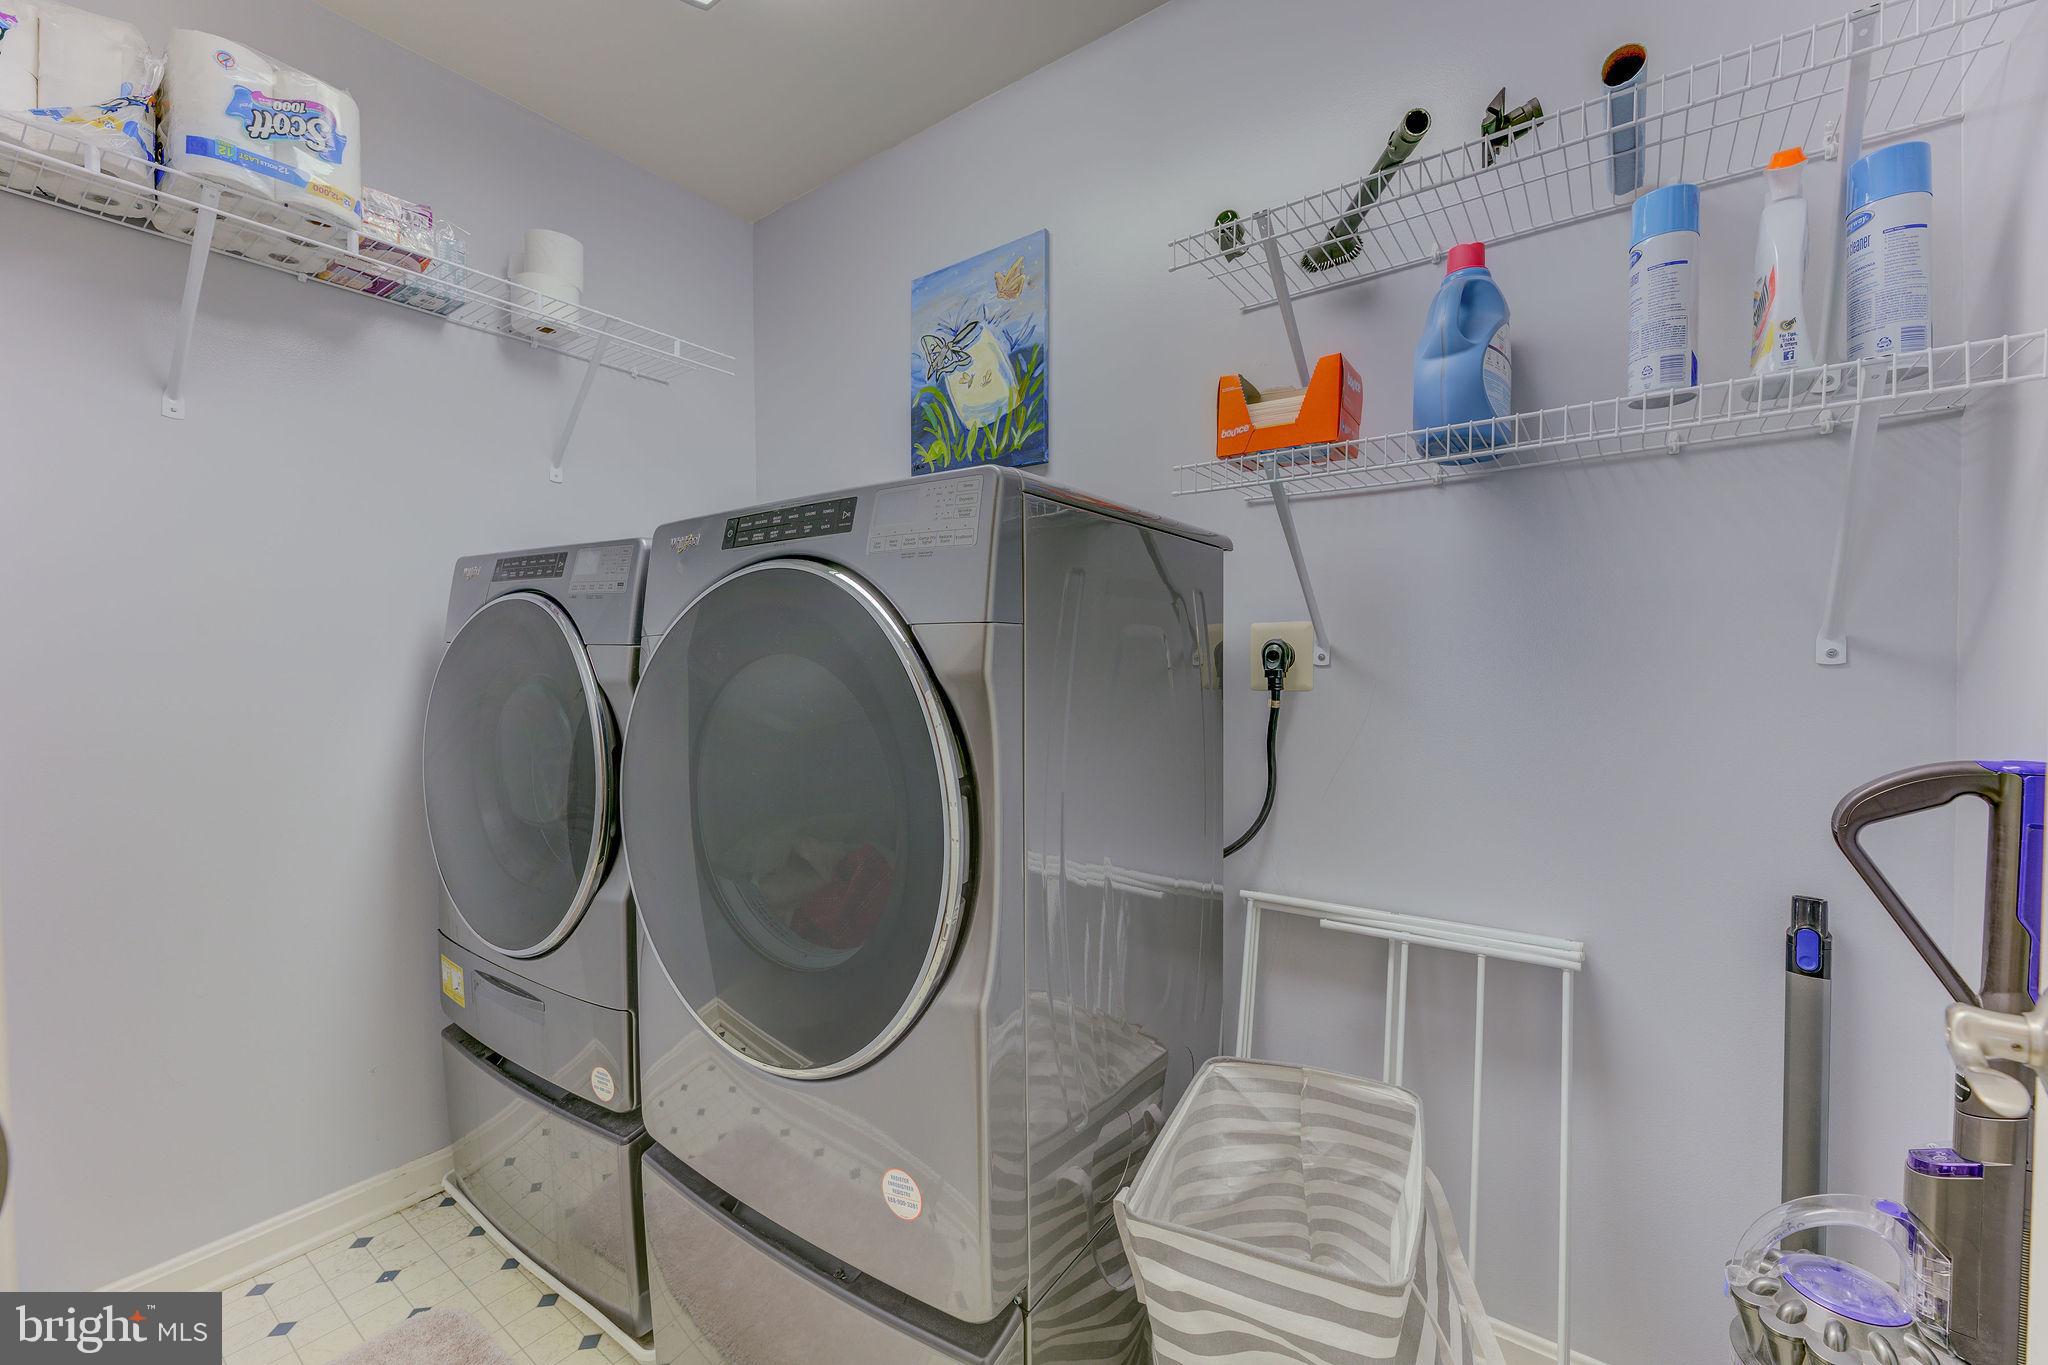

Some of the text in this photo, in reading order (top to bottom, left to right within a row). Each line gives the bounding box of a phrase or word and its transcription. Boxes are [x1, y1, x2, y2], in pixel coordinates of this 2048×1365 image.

[272, 101, 307, 113] 1000
[245, 109, 331, 154] Scott
[218, 145, 233, 156] 12
[239, 152, 259, 165] LAST
[278, 165, 290, 175] 12
[1850, 234, 1871, 256] cleaner
[1221, 424, 1250, 439] bounce
